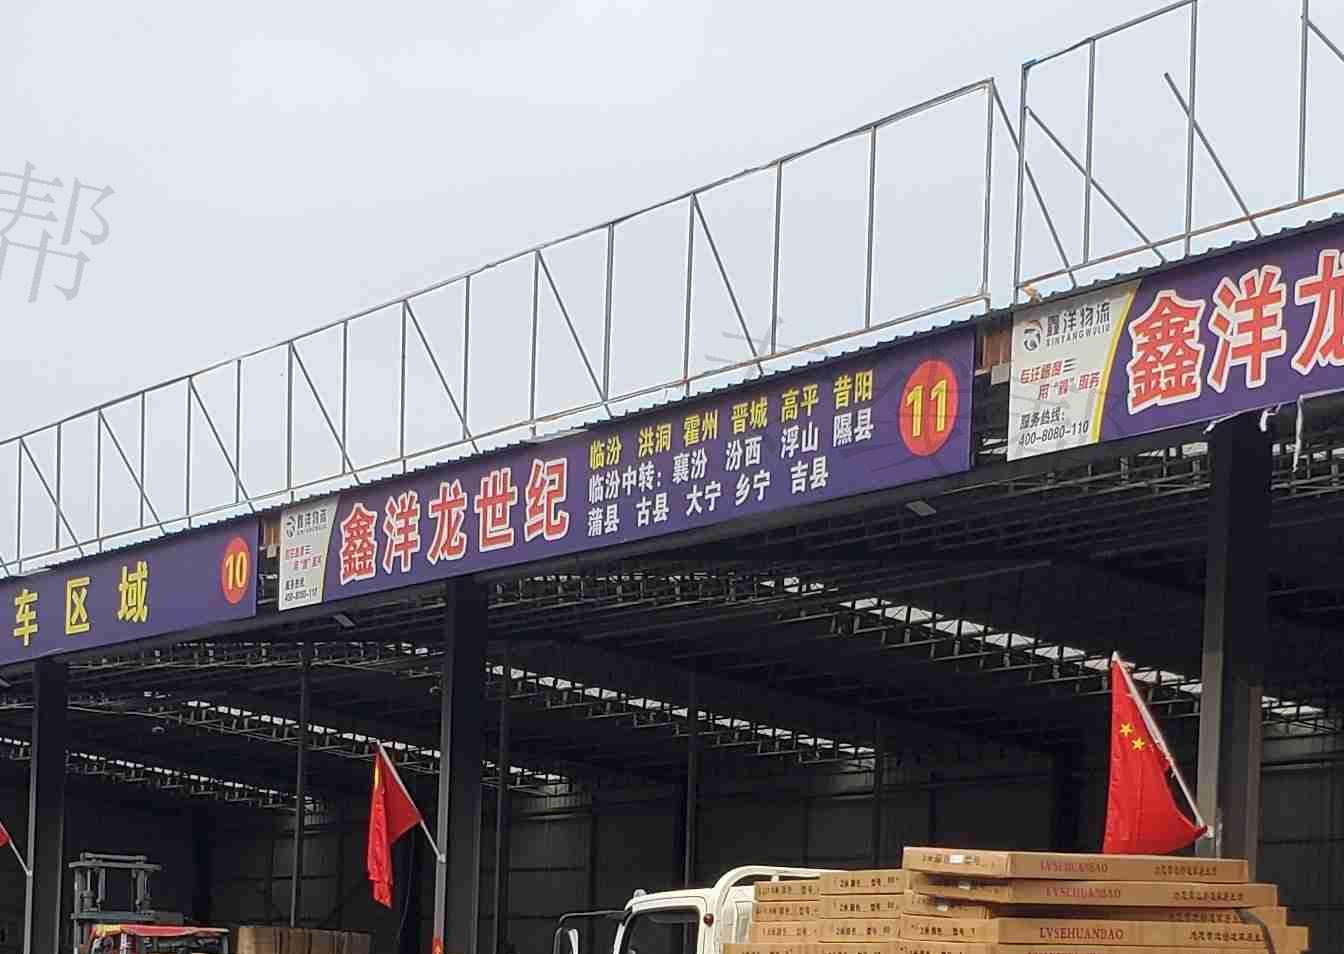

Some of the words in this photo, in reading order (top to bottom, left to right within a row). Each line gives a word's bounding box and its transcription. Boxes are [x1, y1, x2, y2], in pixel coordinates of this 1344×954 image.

[589, 435, 622, 470] 临汾
[638, 423, 672, 457] 洪洞
[683, 409, 718, 447] 霍州
[731, 396, 768, 435] 晋城
[781, 383, 819, 423] 高平
[834, 369, 873, 410] 昔阳
[906, 378, 948, 437] 11
[672, 448, 707, 484] 襄汾
[725, 435, 762, 472] 汾西
[780, 421, 819, 459] 浮山
[340, 457, 569, 585] 鑫洋龙世纪
[636, 492, 669, 527] 古县
[686, 481, 721, 516] 大宁
[735, 470, 771, 506] 乡宁
[791, 455, 829, 494] 吉县
[225, 551, 247, 590] 10
